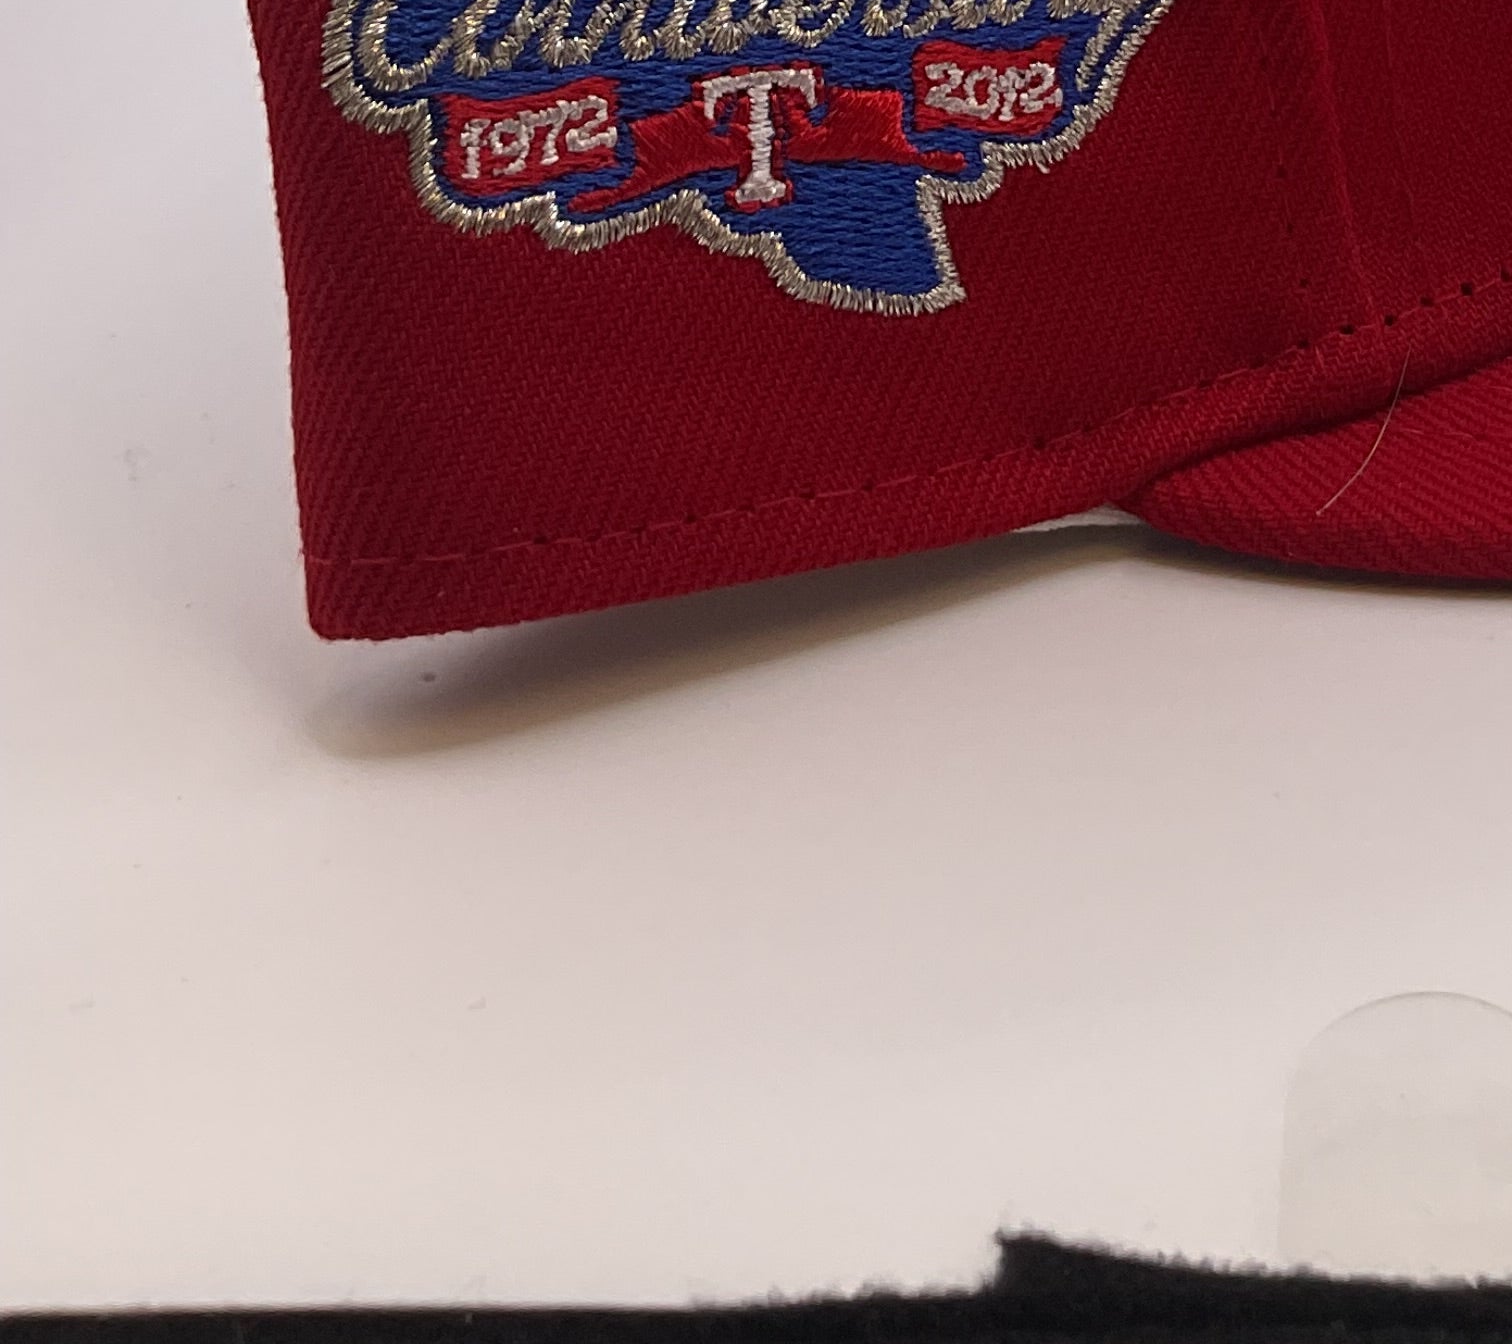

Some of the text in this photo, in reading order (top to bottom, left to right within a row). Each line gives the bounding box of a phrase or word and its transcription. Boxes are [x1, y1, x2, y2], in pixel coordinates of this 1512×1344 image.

[924, 61, 1064, 123] 2012
[460, 97, 617, 180] 1972
[702, 68, 820, 206] T
